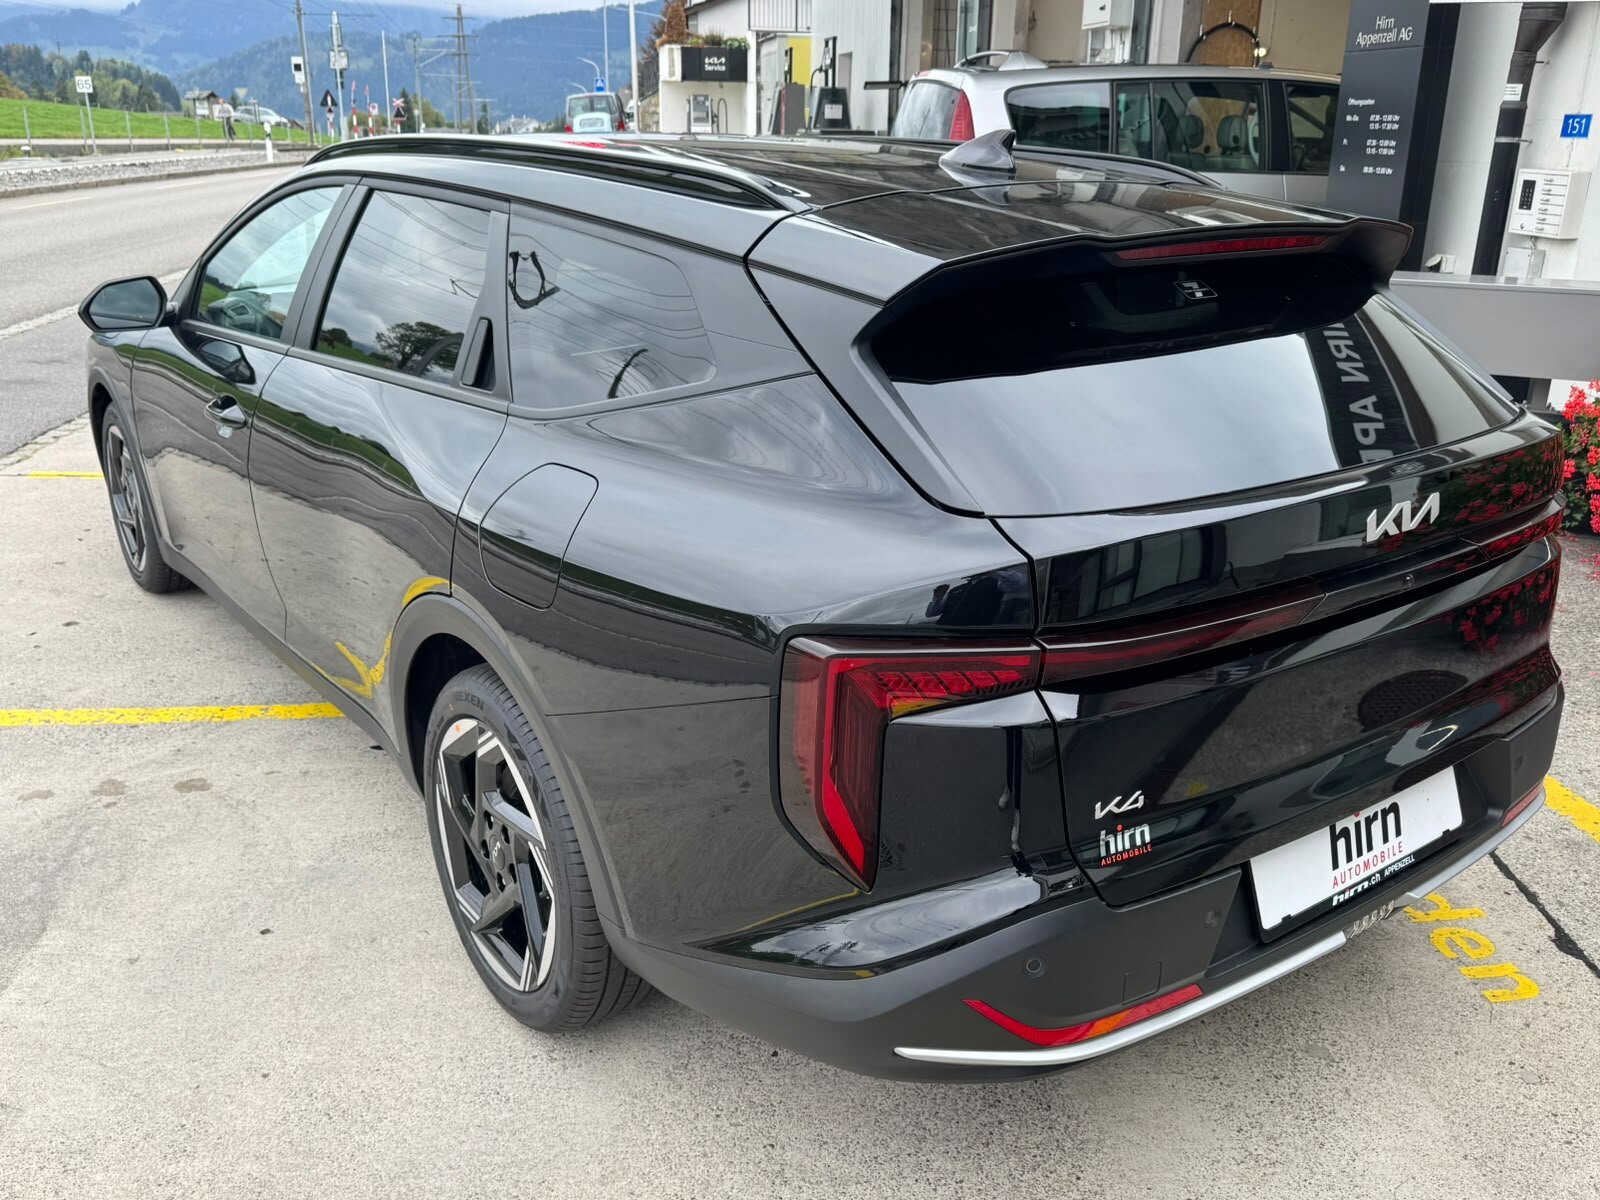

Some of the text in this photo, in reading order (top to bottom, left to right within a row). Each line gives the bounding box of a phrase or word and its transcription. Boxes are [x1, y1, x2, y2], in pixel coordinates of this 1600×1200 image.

[1376, 16, 1394, 30] Hirn
[1355, 26, 1413, 48] Appenzell AG
[77, 79, 92, 90] 65
[1567, 118, 1587, 134] 151
[1366, 492, 1440, 543] KIA
[452, 690, 485, 710] NEXEN
[1094, 790, 1144, 820] K4
[1100, 824, 1151, 857] hirn
[1329, 801, 1402, 872] hirn
[1101, 844, 1152, 866] AUTOMOBILE
[1332, 841, 1404, 889] AUTOMOBILE
[1332, 854, 1416, 906] hirn.ch APPENZELL
